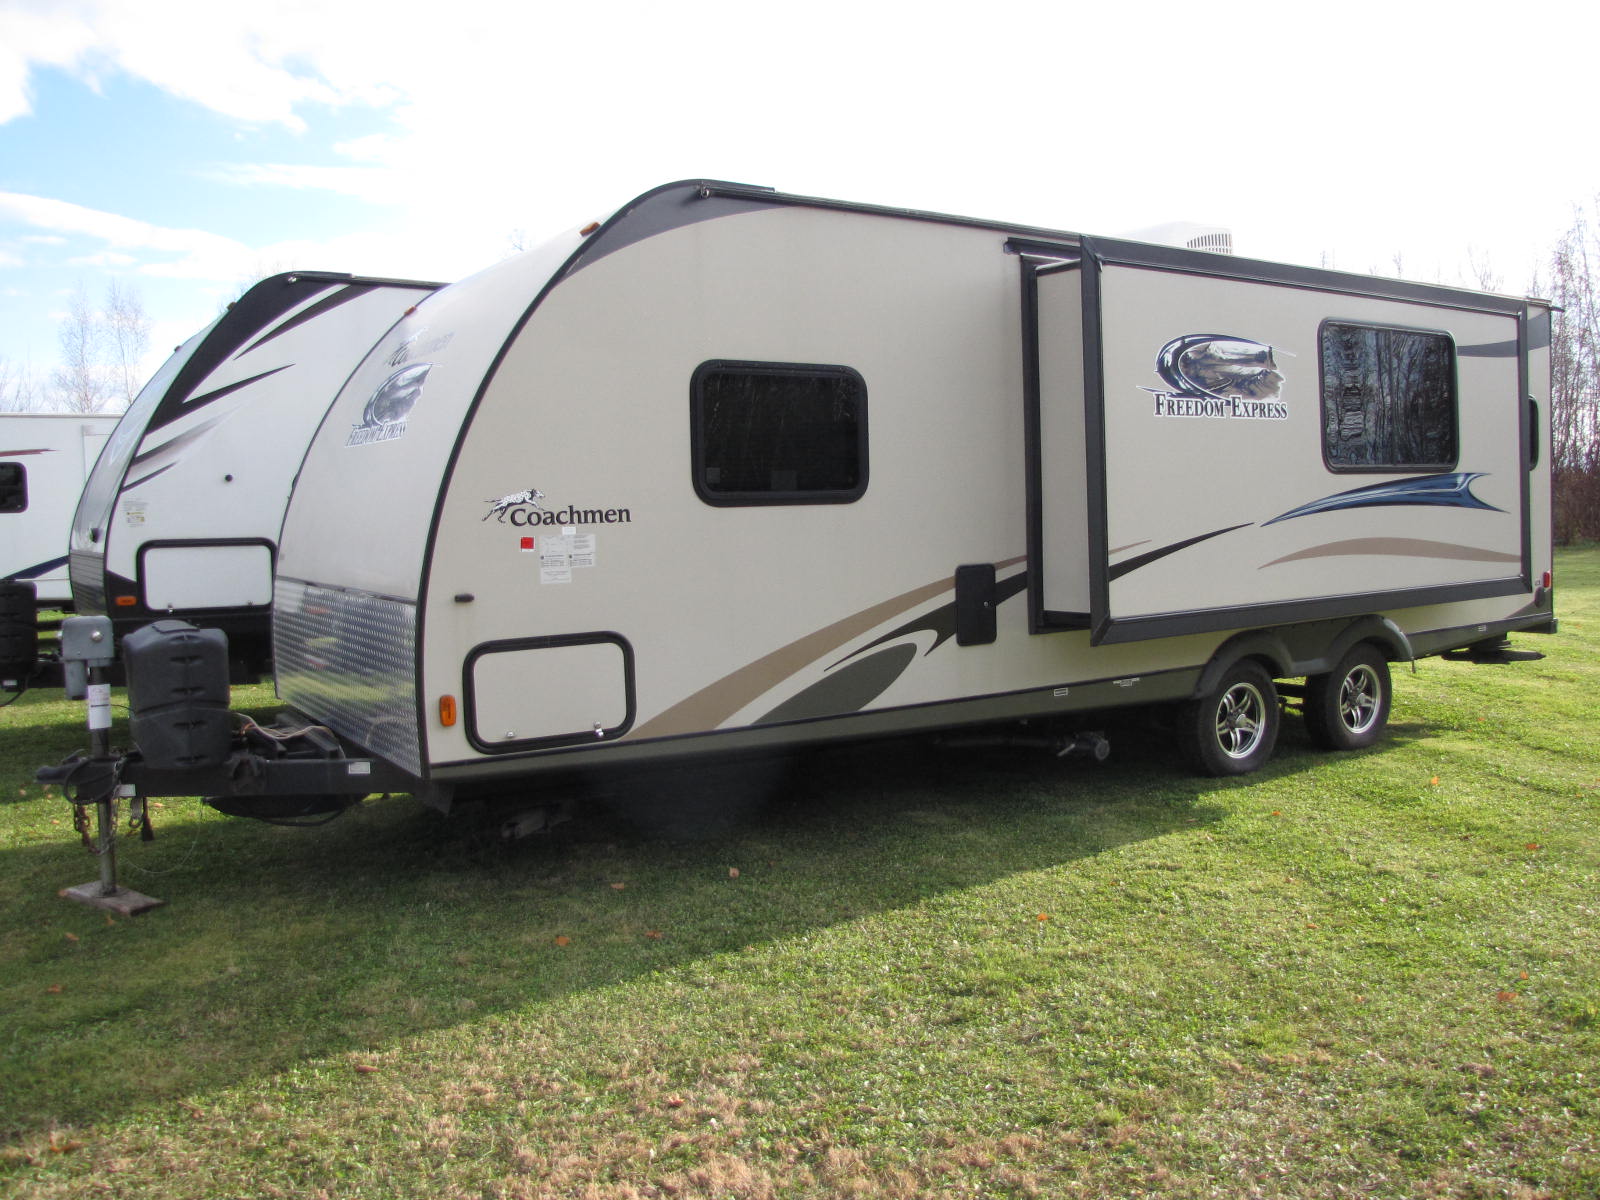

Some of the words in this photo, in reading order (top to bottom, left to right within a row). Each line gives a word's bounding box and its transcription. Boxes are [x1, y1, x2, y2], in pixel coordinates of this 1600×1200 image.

[1154, 394, 1225, 417] FREEDOM
[1230, 396, 1288, 419] EXPRESS
[510, 505, 632, 527] Coachmen
